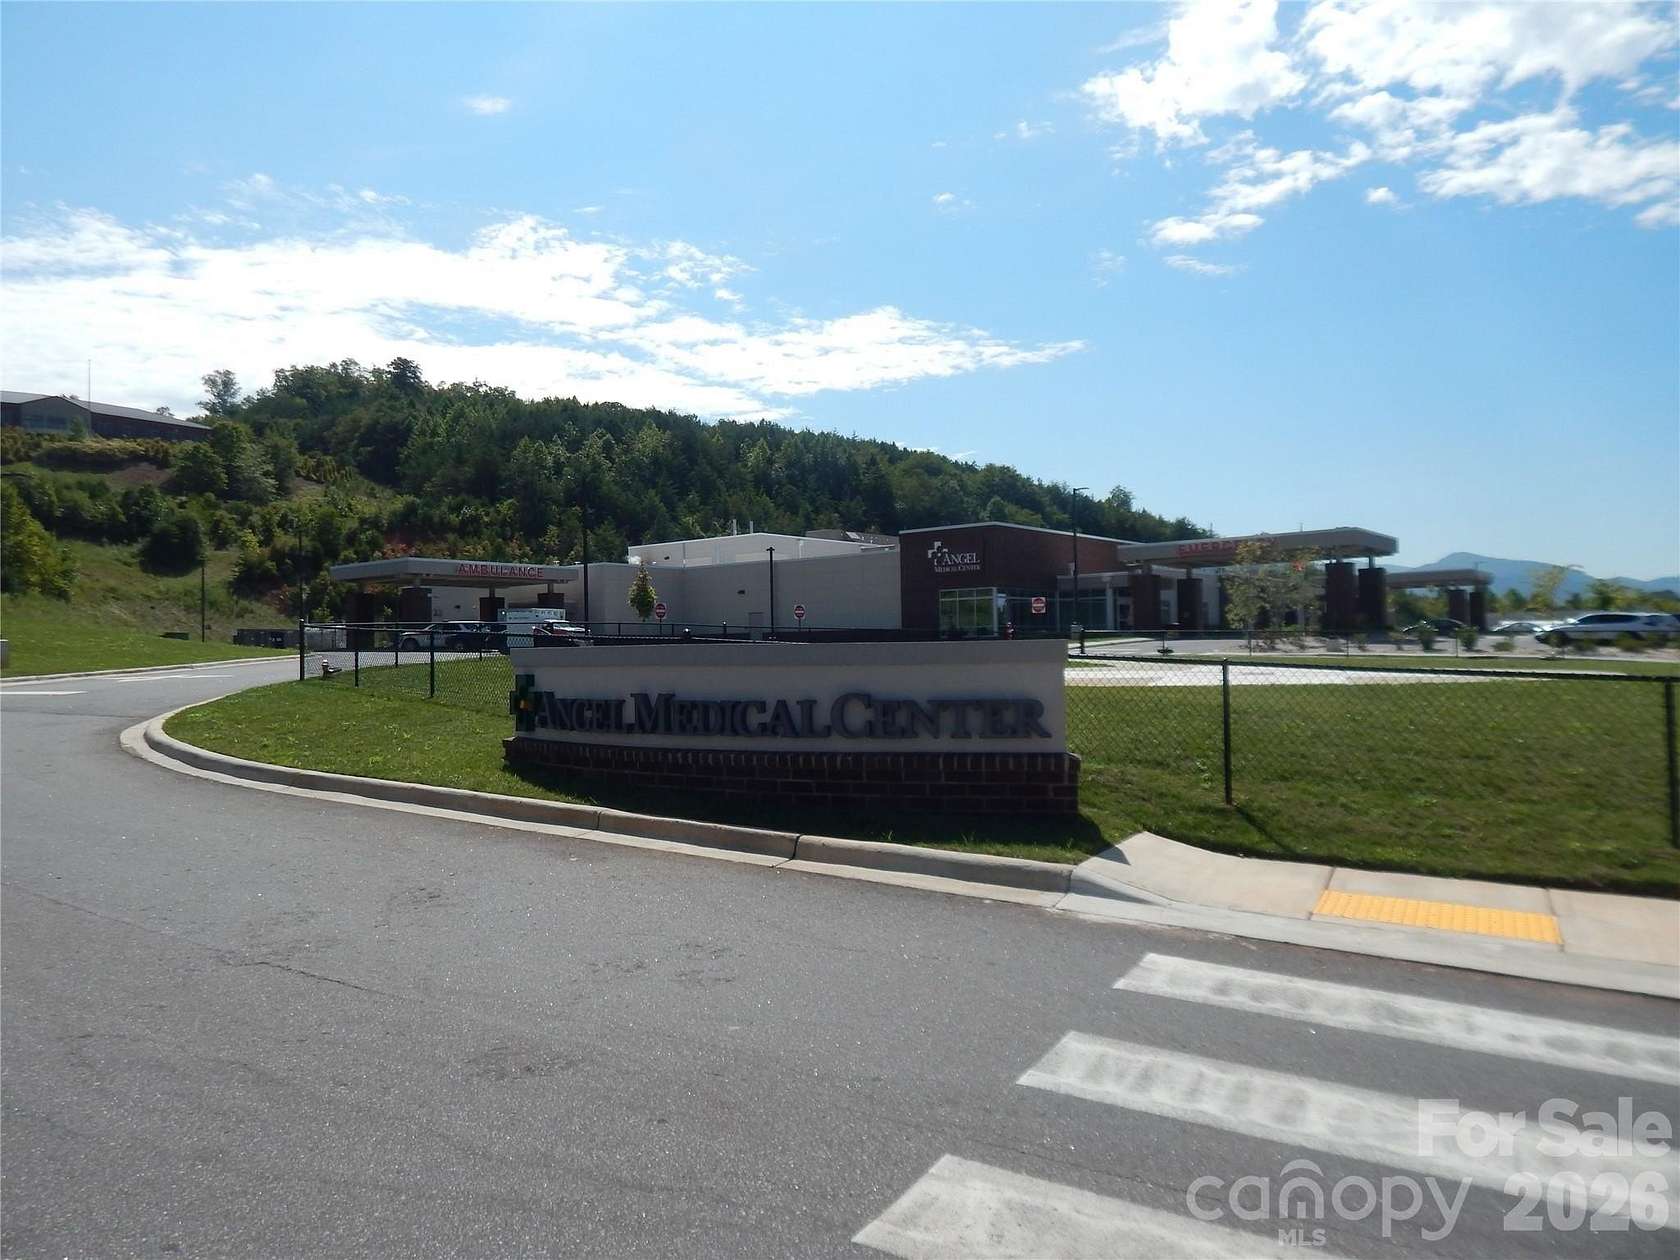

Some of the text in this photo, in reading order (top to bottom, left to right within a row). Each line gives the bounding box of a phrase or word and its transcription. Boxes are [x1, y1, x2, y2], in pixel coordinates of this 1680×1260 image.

[942, 553, 980, 565] ANGEL
[457, 563, 545, 578] AMBULANCE
[534, 691, 1052, 739] ANGEL MEDICAL CENTER
